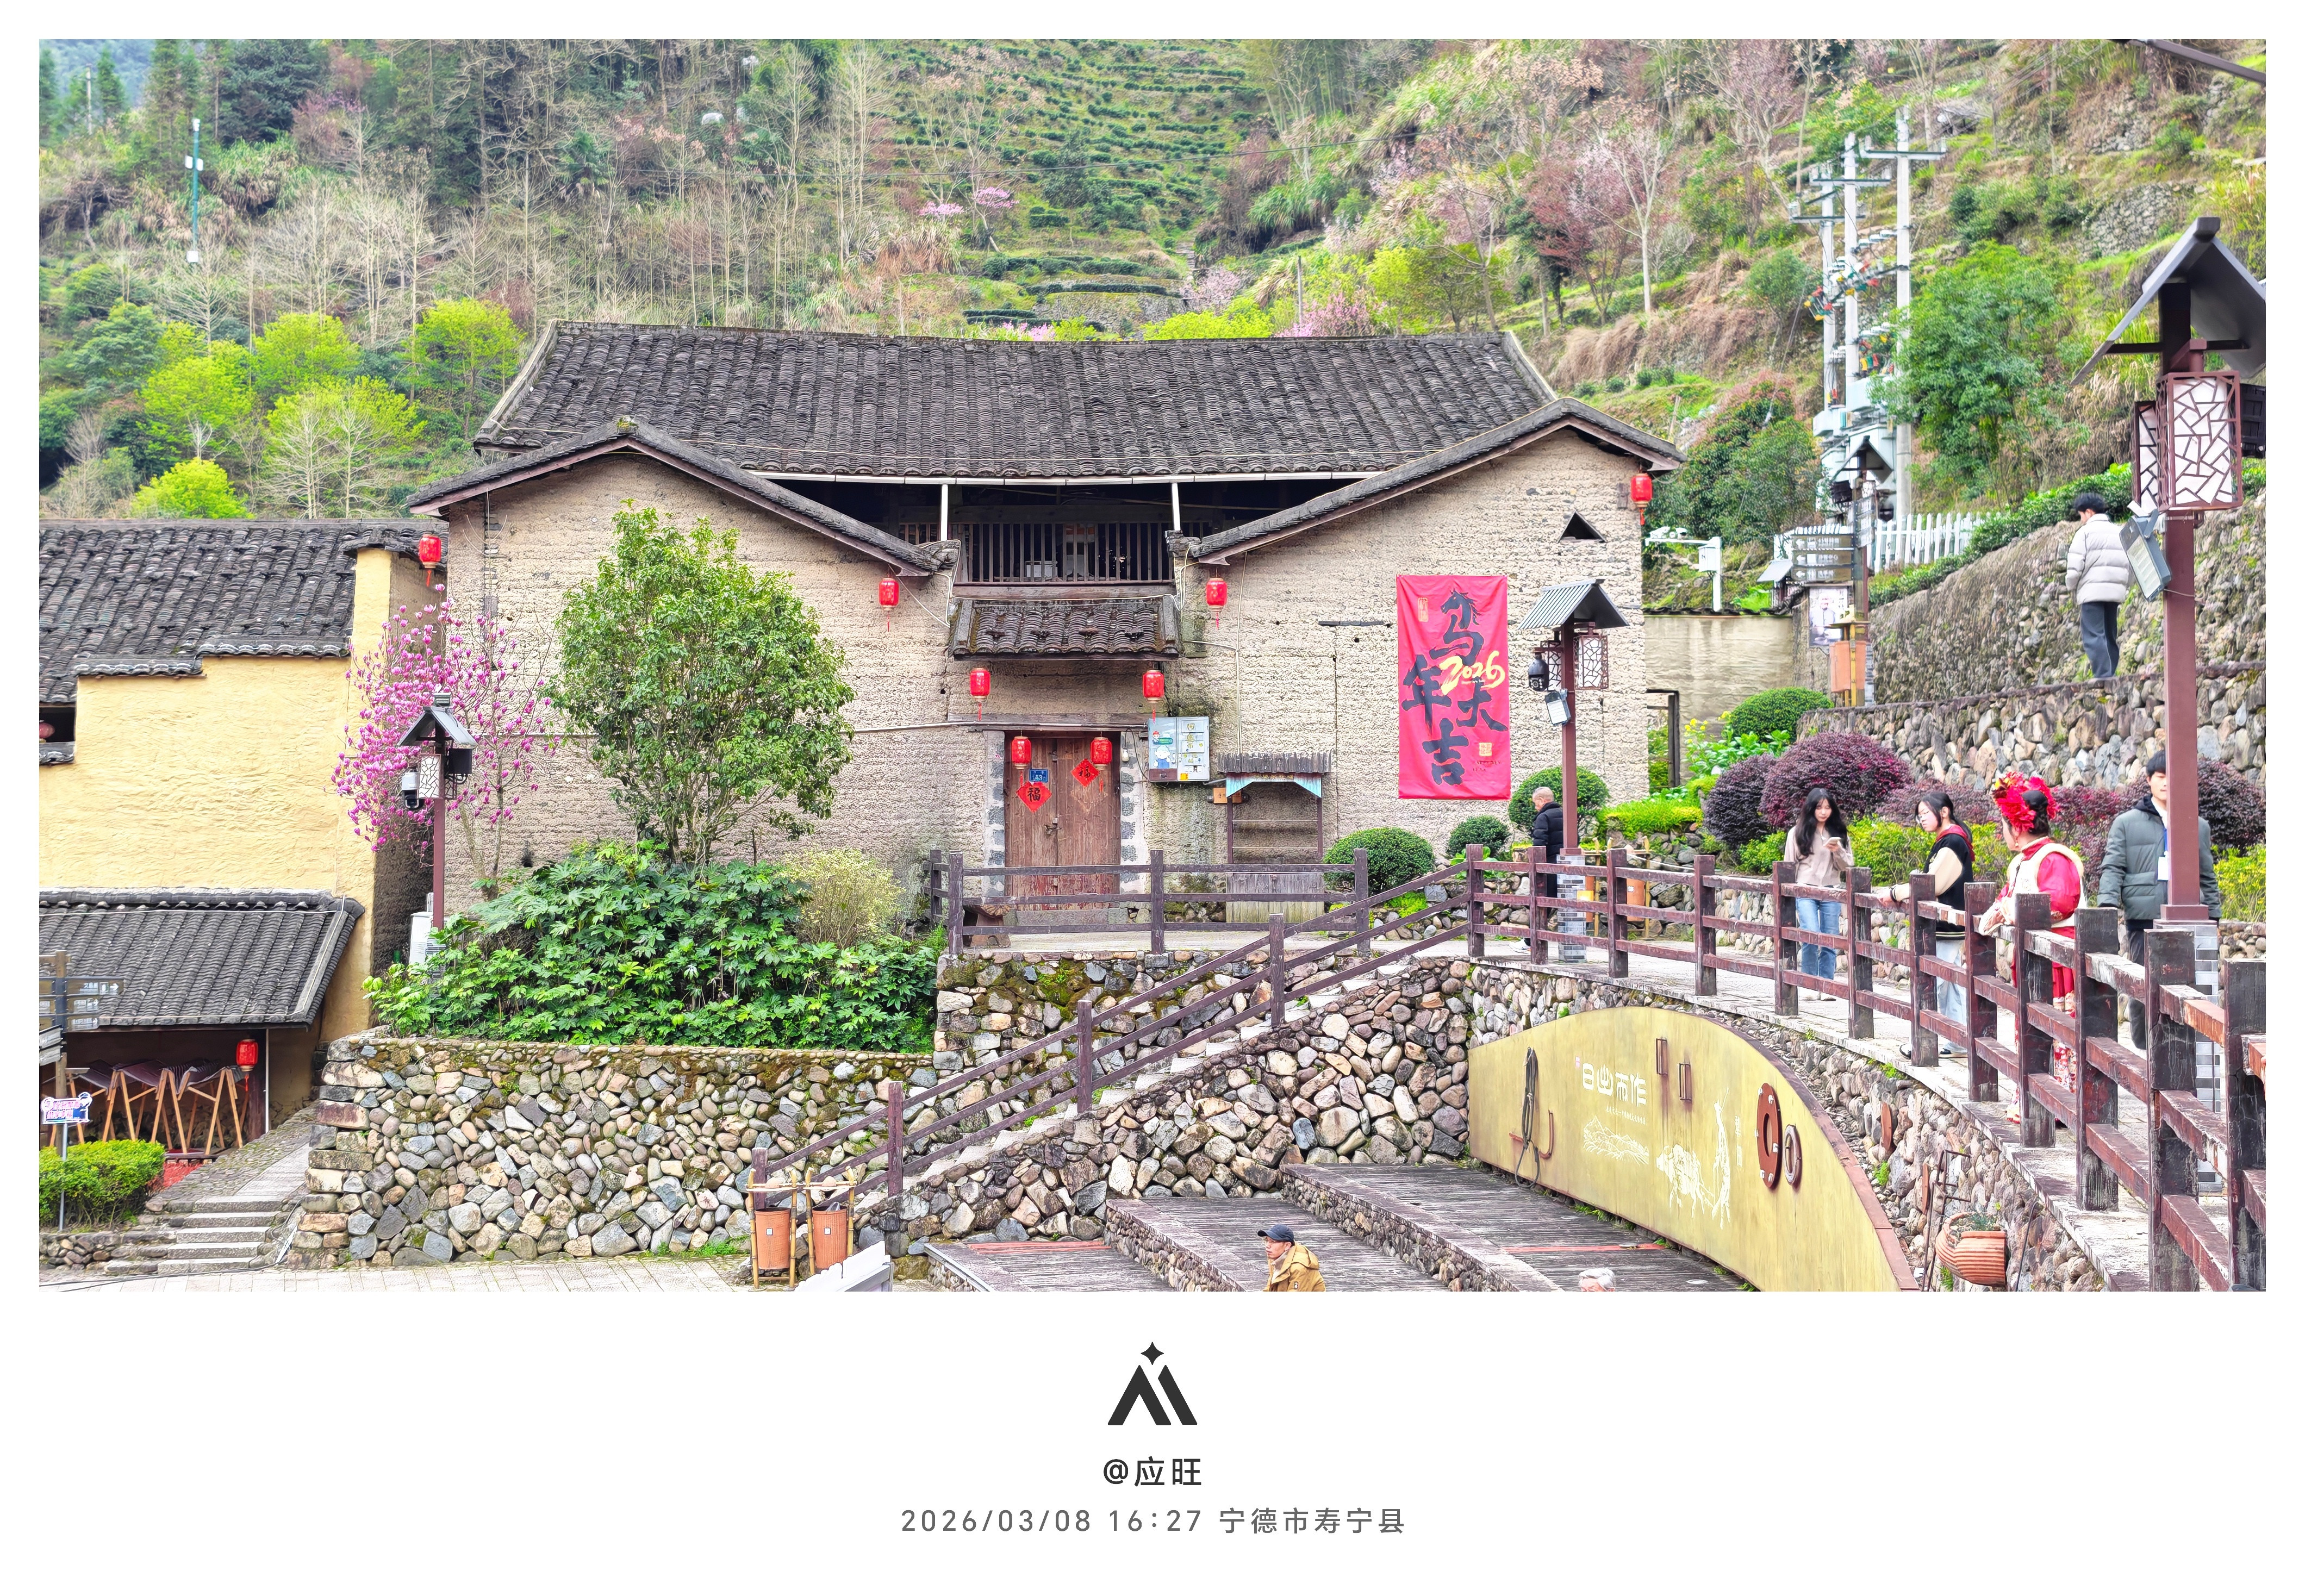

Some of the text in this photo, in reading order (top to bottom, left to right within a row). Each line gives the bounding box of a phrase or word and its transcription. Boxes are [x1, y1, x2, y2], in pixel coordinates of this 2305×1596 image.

[1440, 650, 1505, 696] 2026
[1026, 787, 1042, 802] 福
[1582, 1062, 1647, 1107] 日出而作
